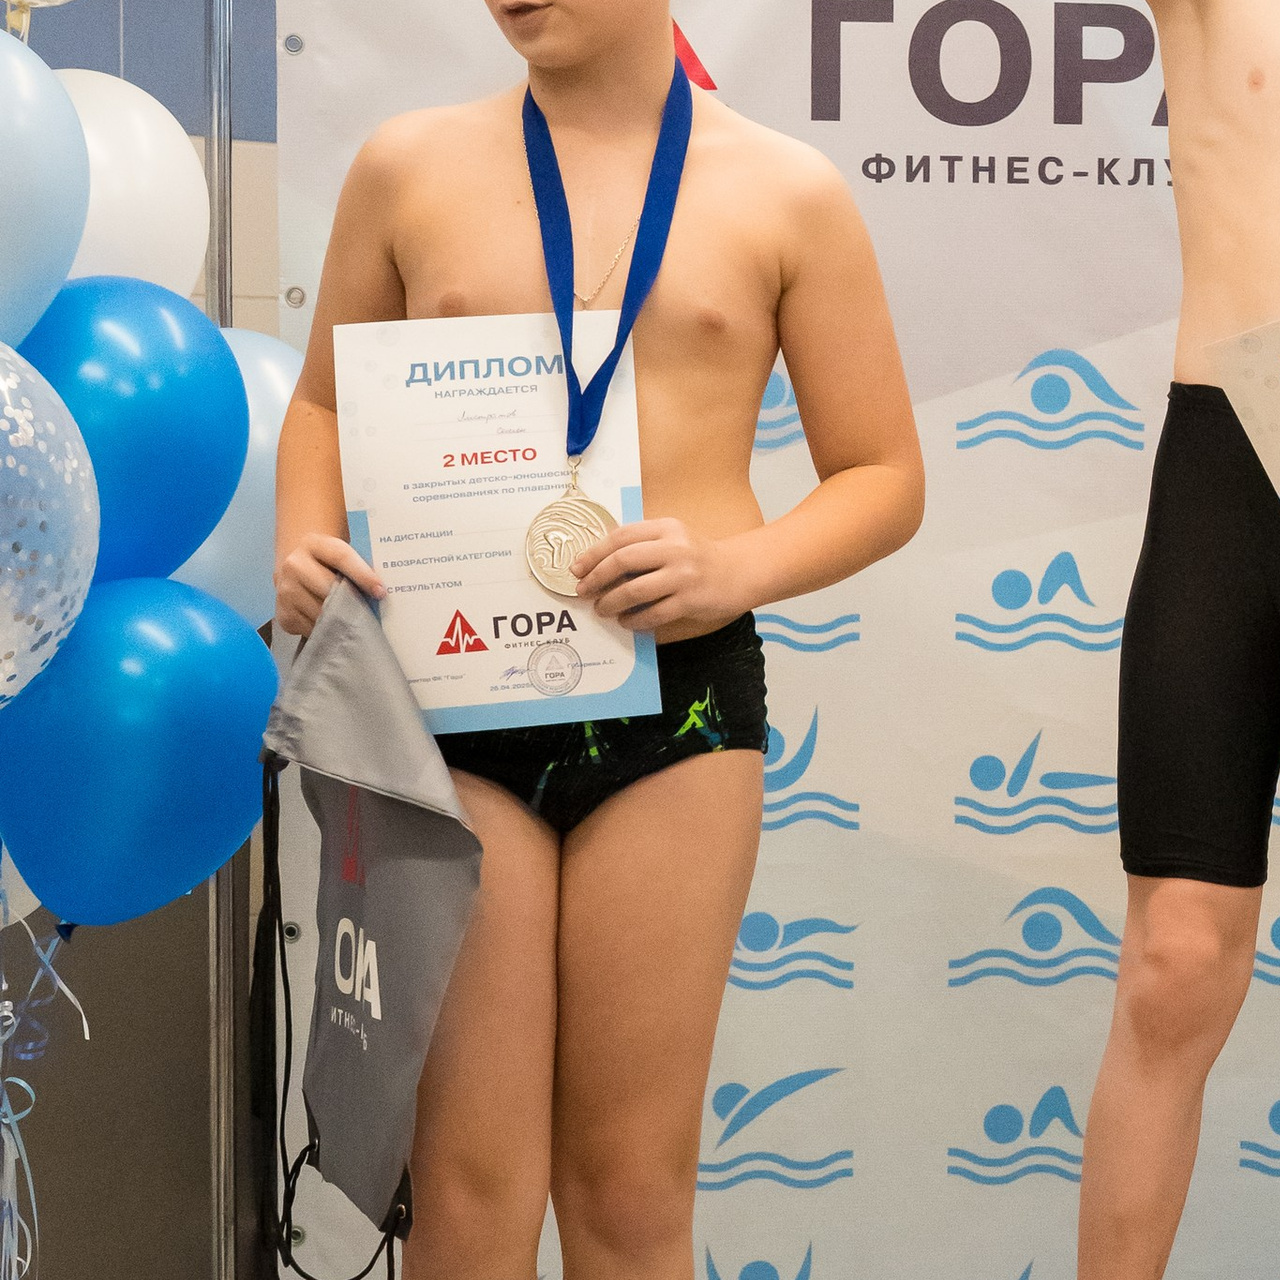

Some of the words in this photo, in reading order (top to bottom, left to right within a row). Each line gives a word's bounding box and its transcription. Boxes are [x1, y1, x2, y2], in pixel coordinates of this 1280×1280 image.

[862, 153, 1173, 186] ФИТНЕС-КЛ
[405, 354, 564, 388] ДИПЛОМ
[434, 384, 538, 399] НАГРАЖДАЕТСЯ
[443, 454, 456, 468] 2
[460, 447, 538, 467] МЕСТО
[403, 483, 410, 491] в
[412, 478, 466, 490] закрытых
[412, 488, 500, 503] соревнованиях
[501, 486, 516, 495] по
[379, 535, 392, 544] НА
[393, 529, 454, 544] ДИСТАНЦИИ
[382, 561, 390, 569] В
[390, 554, 455, 569] ВОЗРАСТНОЙ
[456, 549, 512, 562] КАТЕГОРИИ
[394, 580, 463, 593] РЕЗУЛЬТАТОМ
[492, 609, 578, 640] ГОРА
[544, 671, 565, 680] ГОРА
